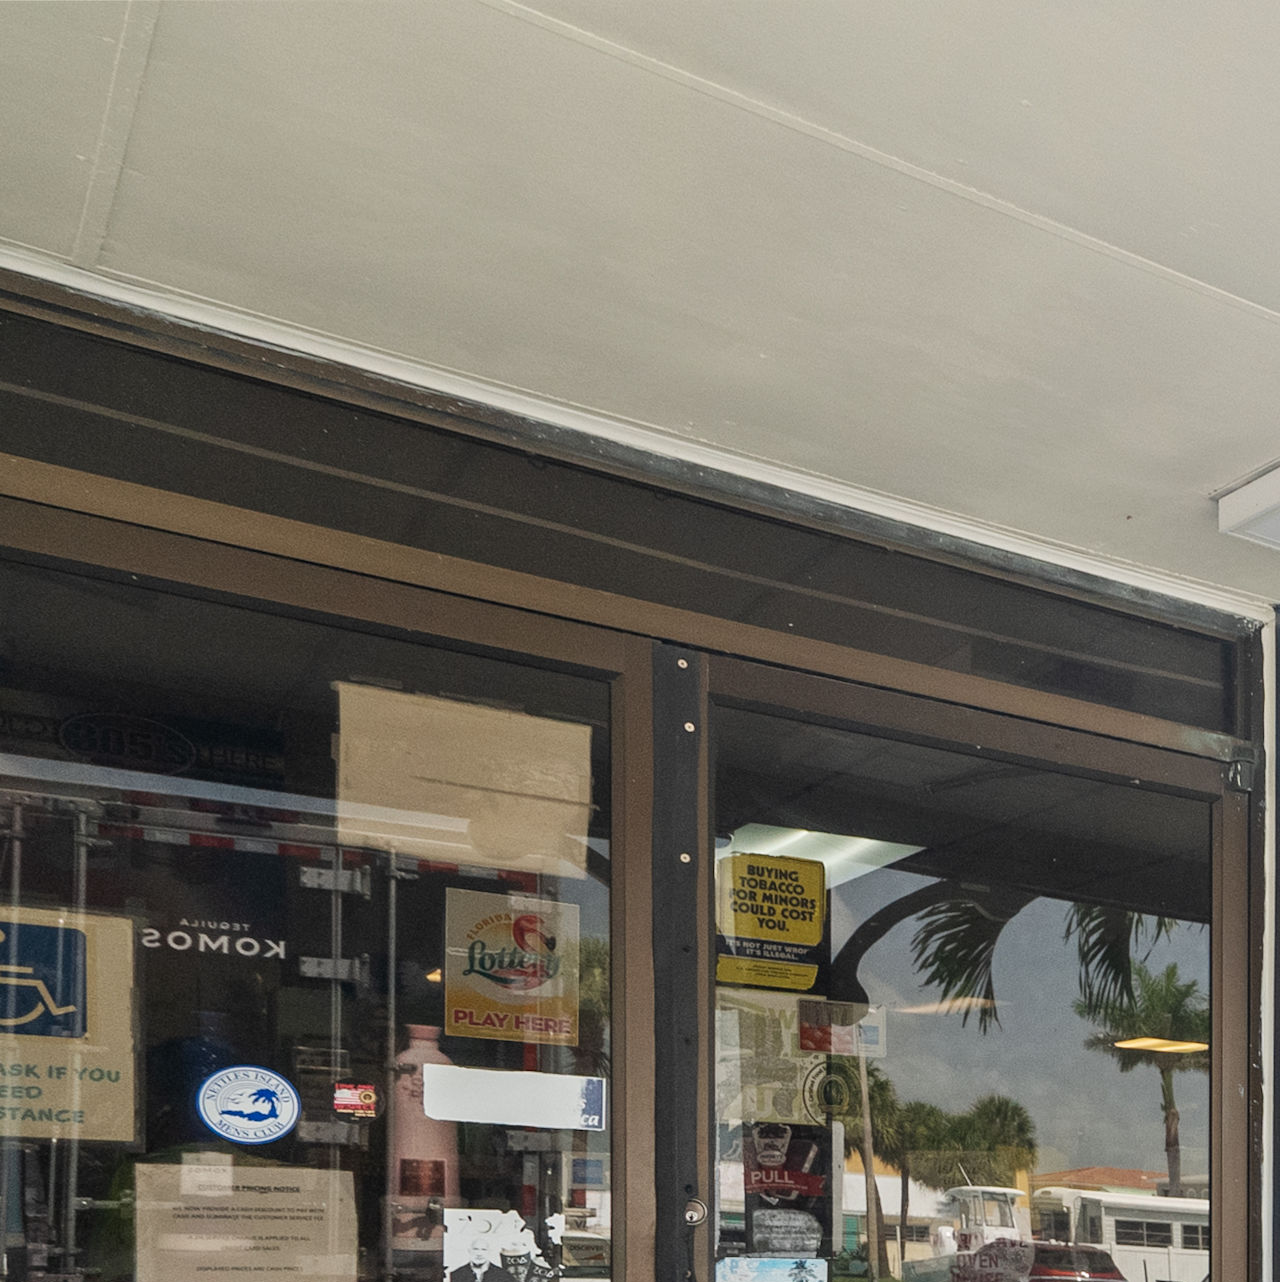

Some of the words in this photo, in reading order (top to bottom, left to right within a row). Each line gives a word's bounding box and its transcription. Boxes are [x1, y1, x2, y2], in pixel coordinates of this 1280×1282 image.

[747, 864, 799, 882] BUYING
[739, 876, 804, 895] TOBACCO
[729, 888, 757, 902] FOR
[762, 891, 816, 910] MINORS
[730, 901, 776, 916] COULD
[781, 909, 815, 922] COST
[467, 913, 512, 941] FLORIDA
[757, 917, 790, 932] YOU.
[763, 943, 782, 951] JUST
[463, 940, 560, 984] Lottery
[454, 1009, 509, 1028] PLAY
[515, 1015, 571, 1034] HERE
[48, 1065, 68, 1080] IF
[78, 1068, 121, 1083] YOU
[206, 1072, 251, 1101] NETTLES
[254, 1072, 291, 1103] ISLAND
[217, 1119, 250, 1137] MENS
[253, 1121, 285, 1138] CLUB
[751, 1170, 795, 1184] PULL
[956, 1254, 999, 1268] OVEN
